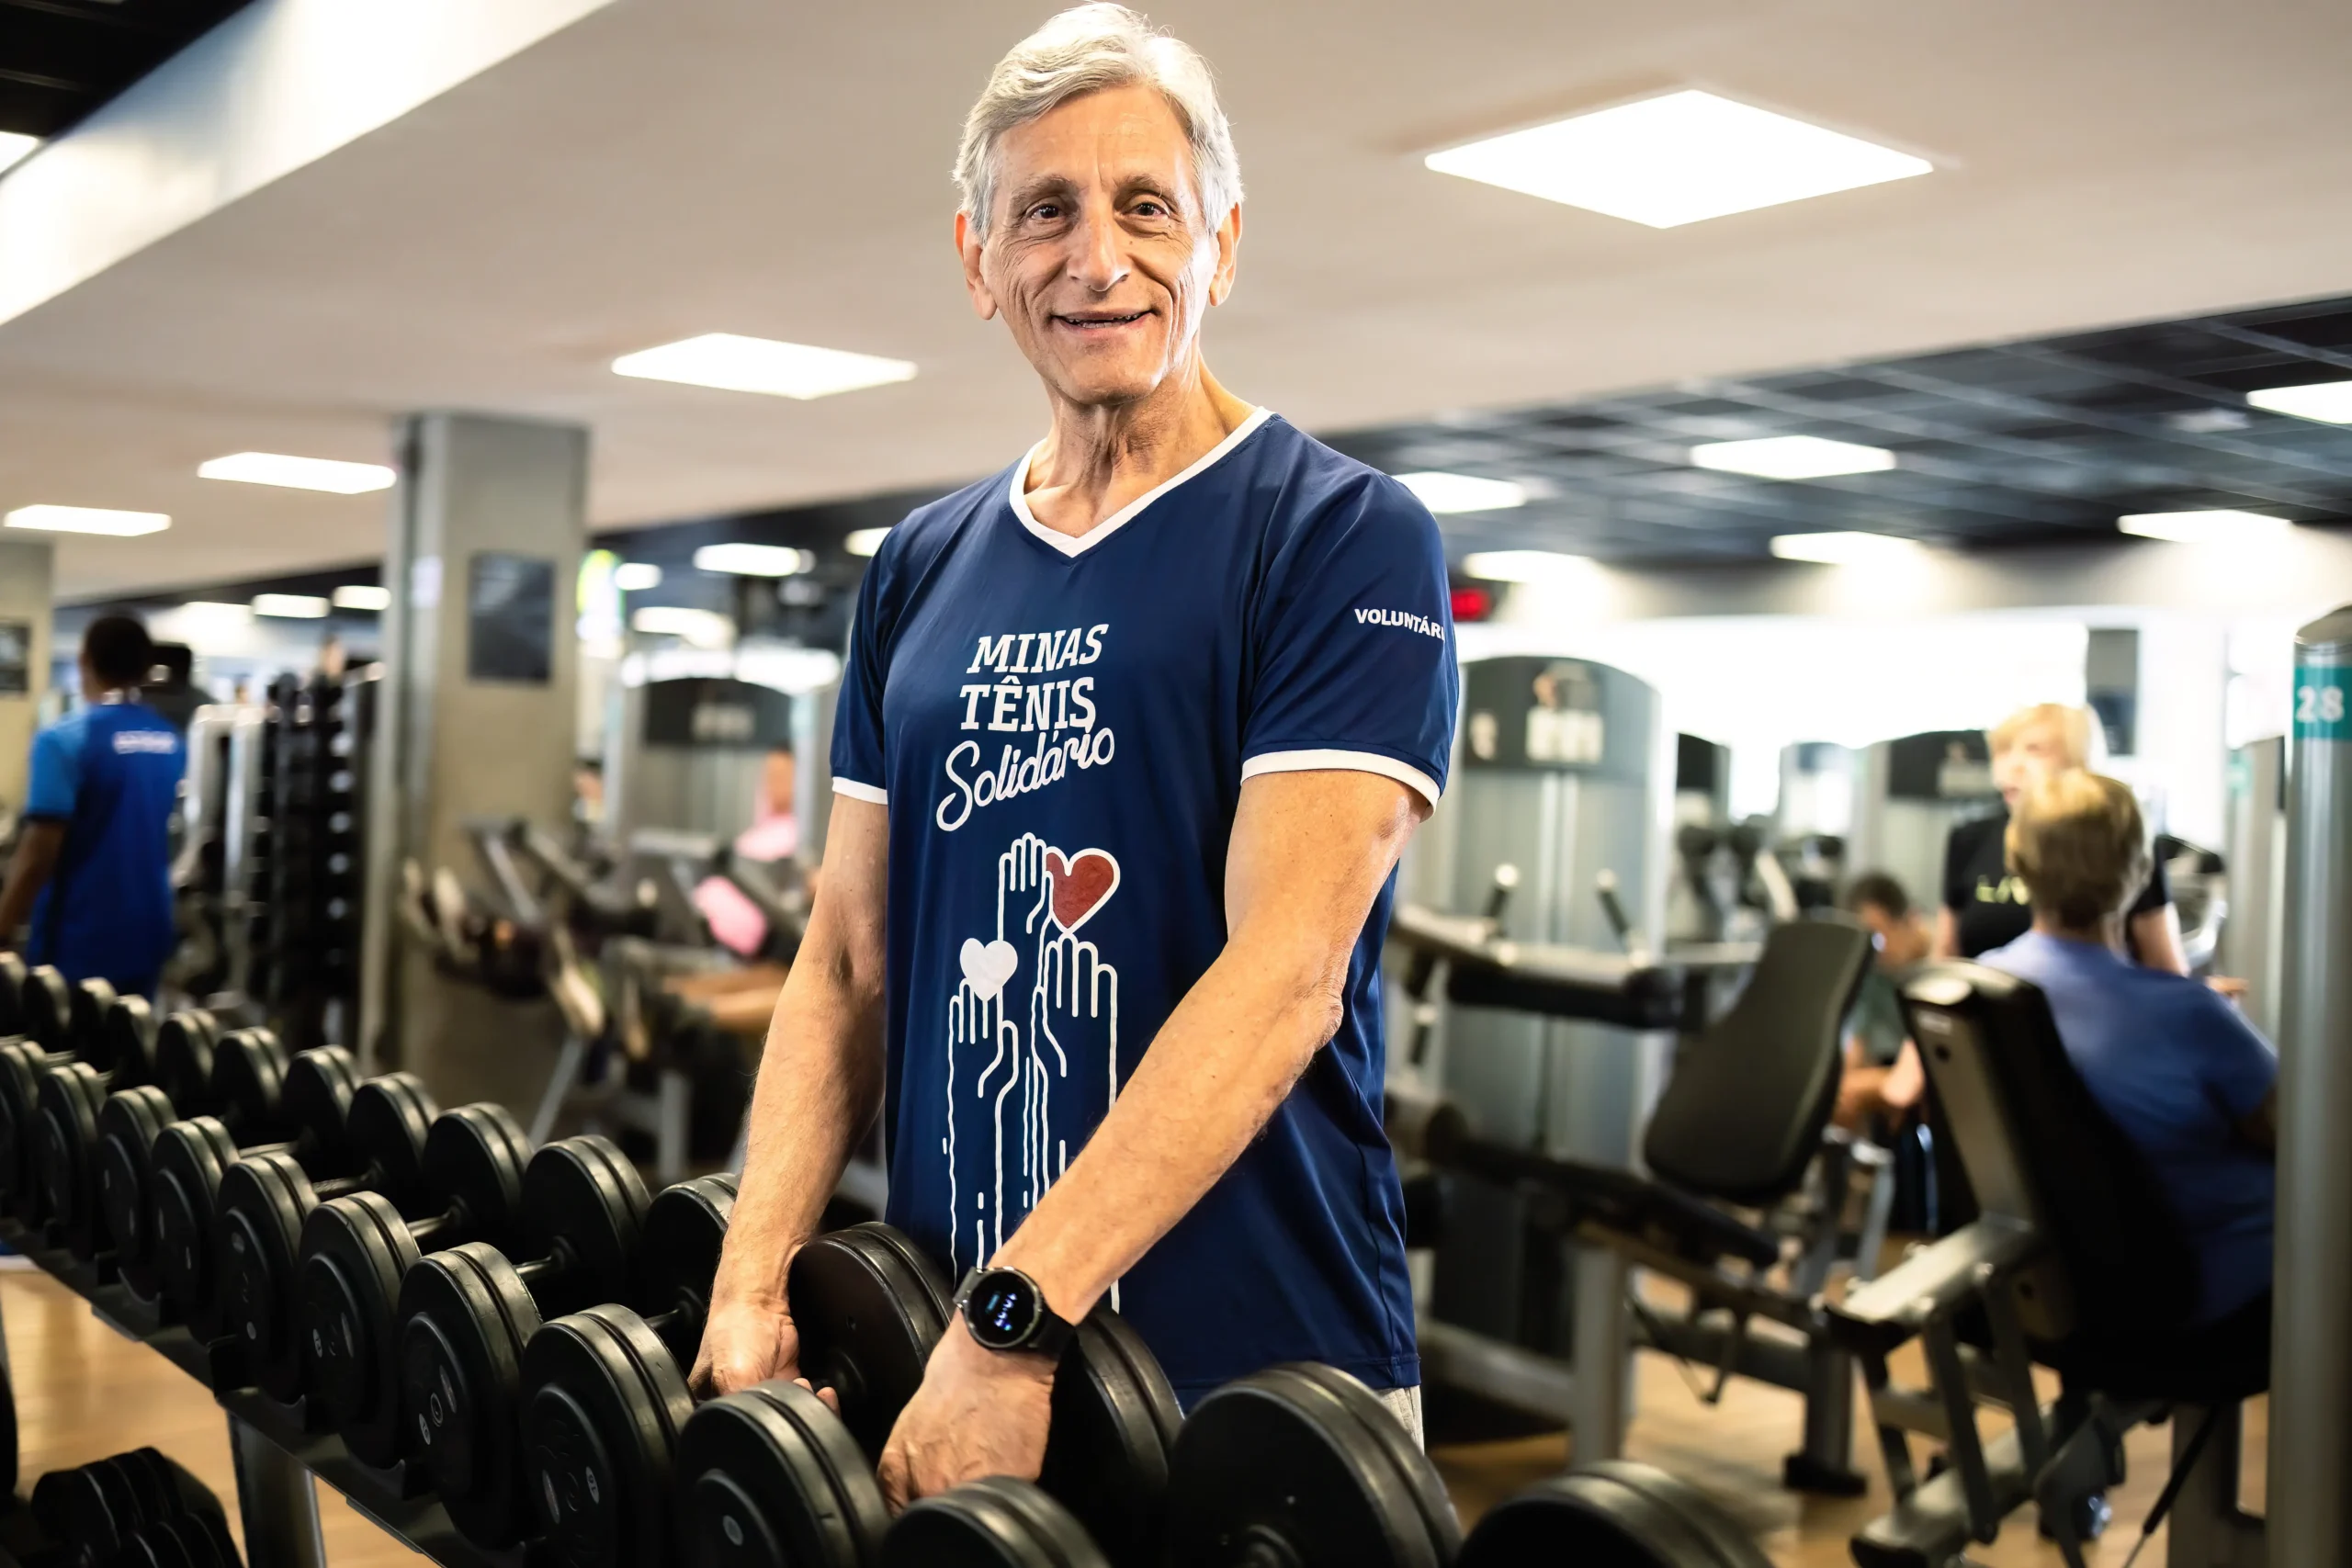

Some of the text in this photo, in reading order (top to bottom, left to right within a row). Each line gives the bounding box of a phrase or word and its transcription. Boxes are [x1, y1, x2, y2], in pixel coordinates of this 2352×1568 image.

[966, 623, 1110, 674] MINAS
[959, 675, 1097, 733] TÊNIS
[935, 726, 1115, 832] Solidário
